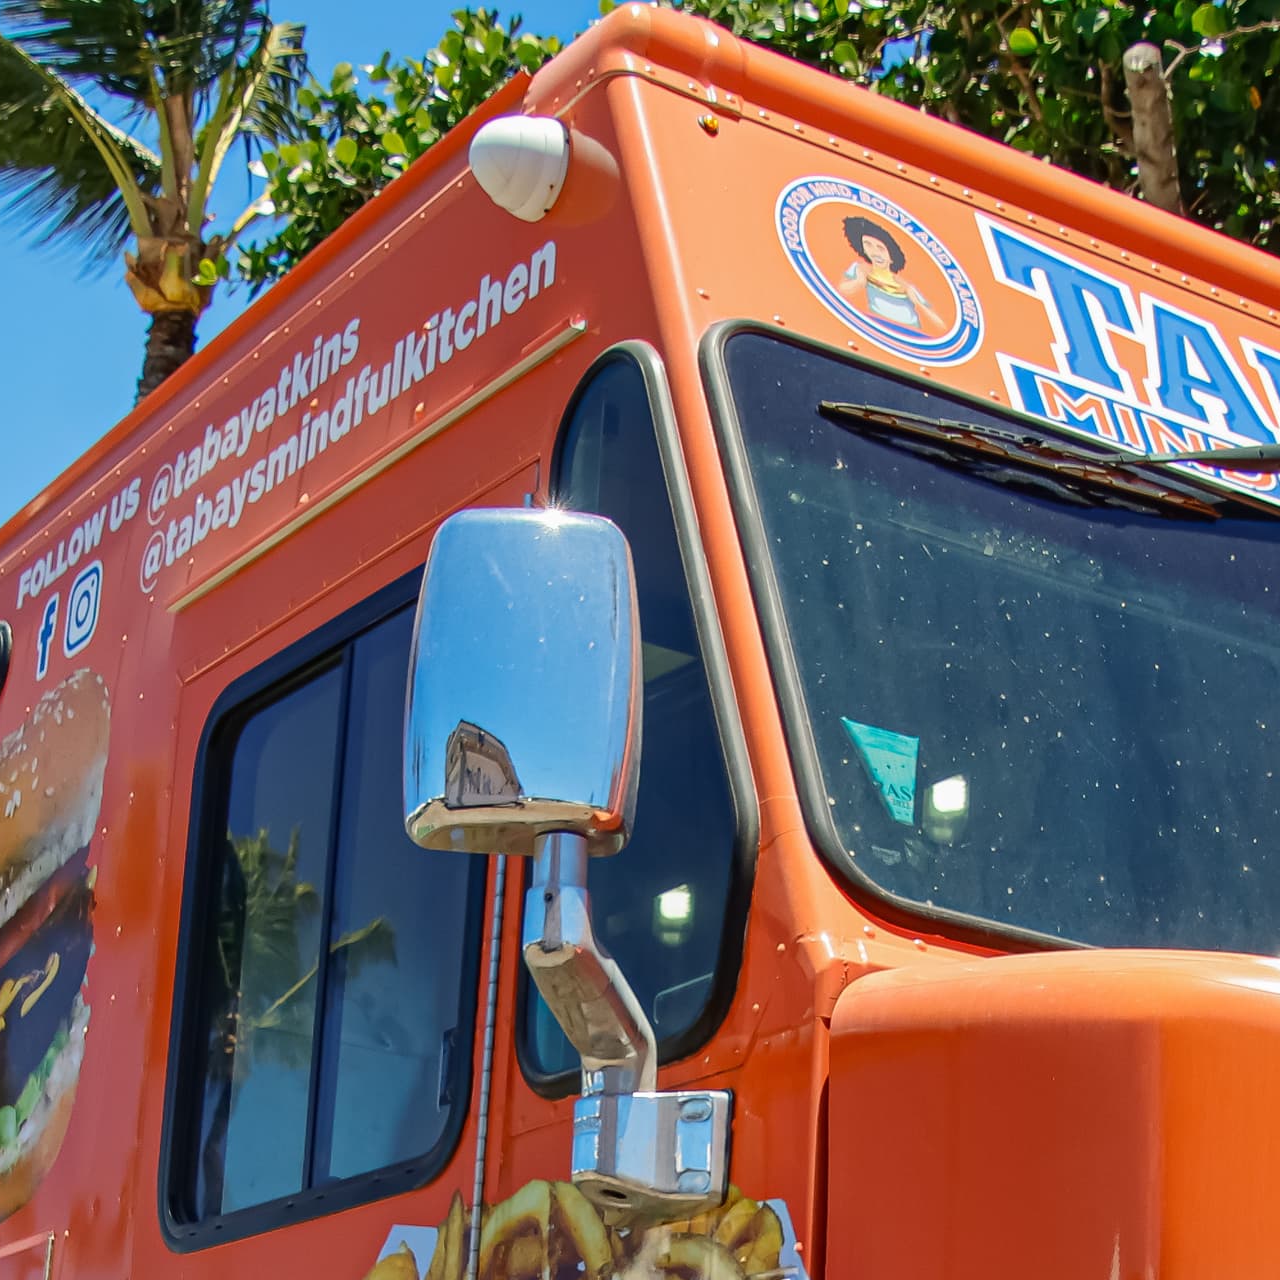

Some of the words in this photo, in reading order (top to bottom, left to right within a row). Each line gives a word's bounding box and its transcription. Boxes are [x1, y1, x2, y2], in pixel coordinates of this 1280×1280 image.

[782, 206, 803, 253] FOOD
[786, 186, 815, 212] FOR
[914, 231, 951, 266] AND
[140, 240, 558, 594] @tabaysmindfulkitchen
[147, 317, 361, 526] @tabayatkins
[17, 506, 107, 609] FOLLOW
[108, 477, 141, 534] US
